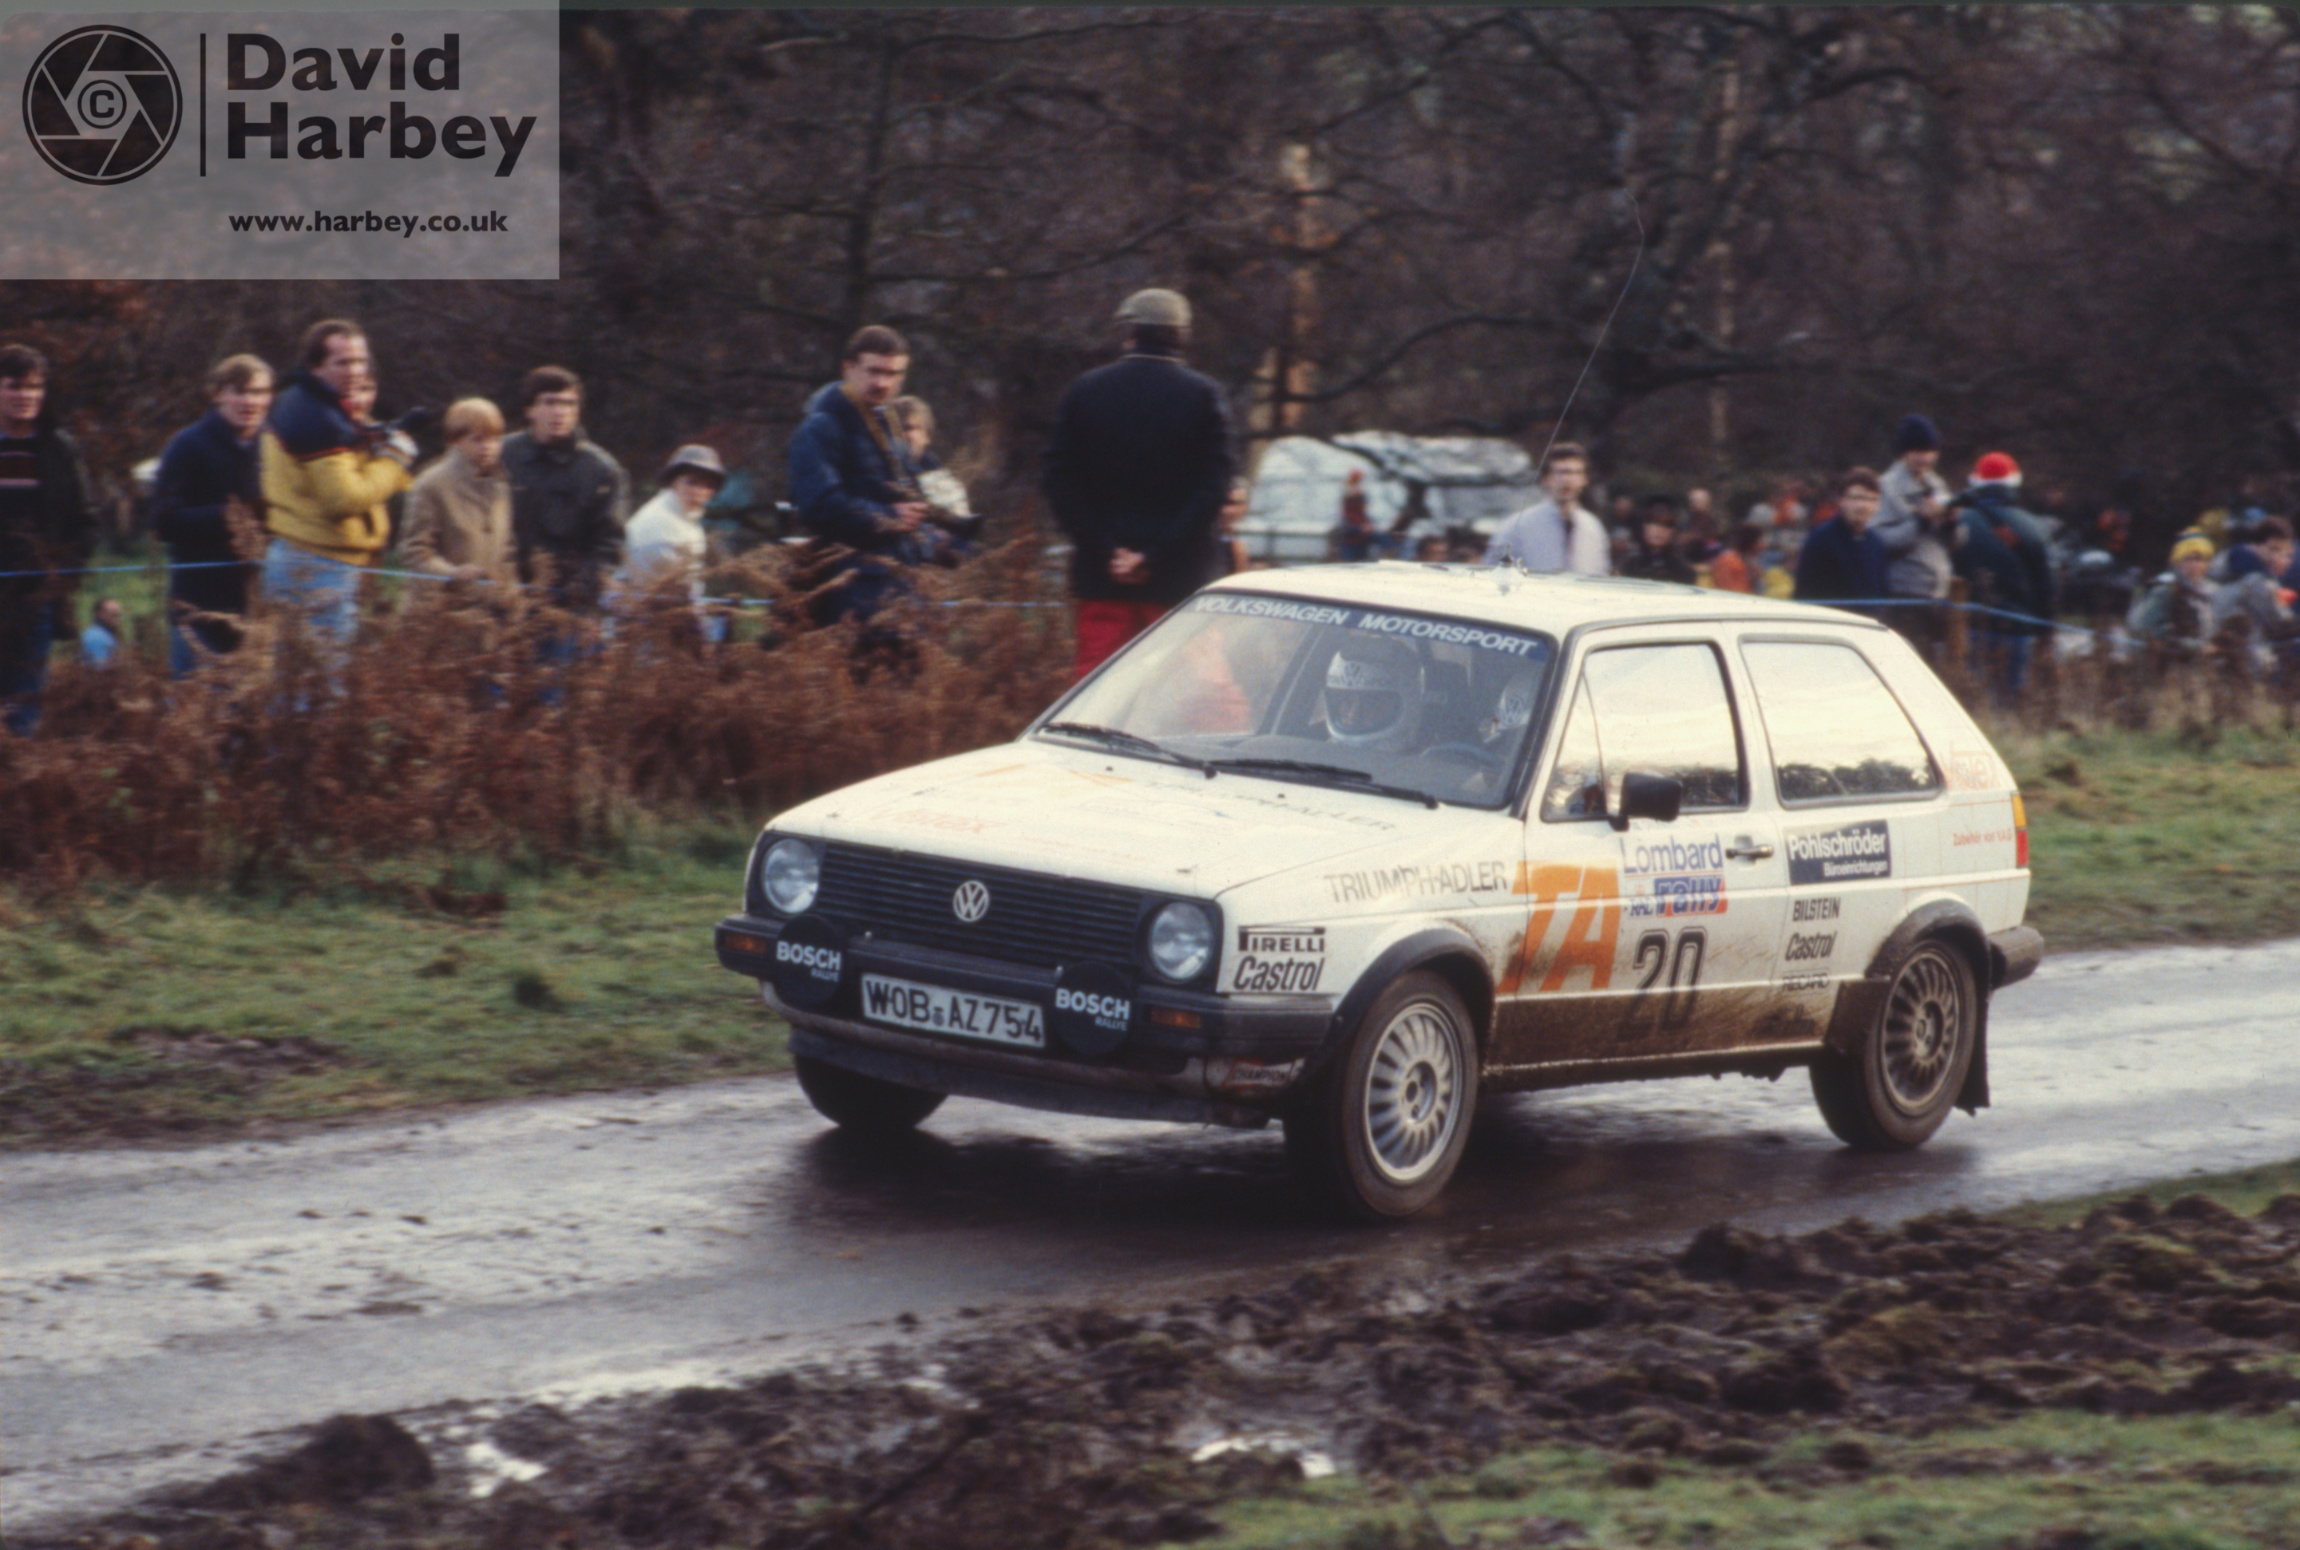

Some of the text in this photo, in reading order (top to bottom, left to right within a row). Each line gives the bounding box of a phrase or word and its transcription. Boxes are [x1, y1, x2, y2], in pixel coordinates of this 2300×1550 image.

[1195, 597, 1538, 656] VOLKSWAGEN MOTORSPORT
[1620, 833, 1724, 875] Lombard
[1787, 828, 1887, 860] Pohlschröder
[953, 880, 990, 922] VW
[1656, 875, 1723, 914] rally
[1793, 897, 1841, 921] BILSTEIN
[1238, 926, 1326, 952] PIRELLI
[1496, 860, 1621, 993] TA
[777, 940, 842, 971] BOSCH
[1785, 930, 1837, 961] Castrol
[1233, 955, 1326, 991] Castrol
[1619, 926, 1709, 1041] 20
[866, 980, 931, 1023] WOB
[1056, 988, 1130, 1020] BOSCH
